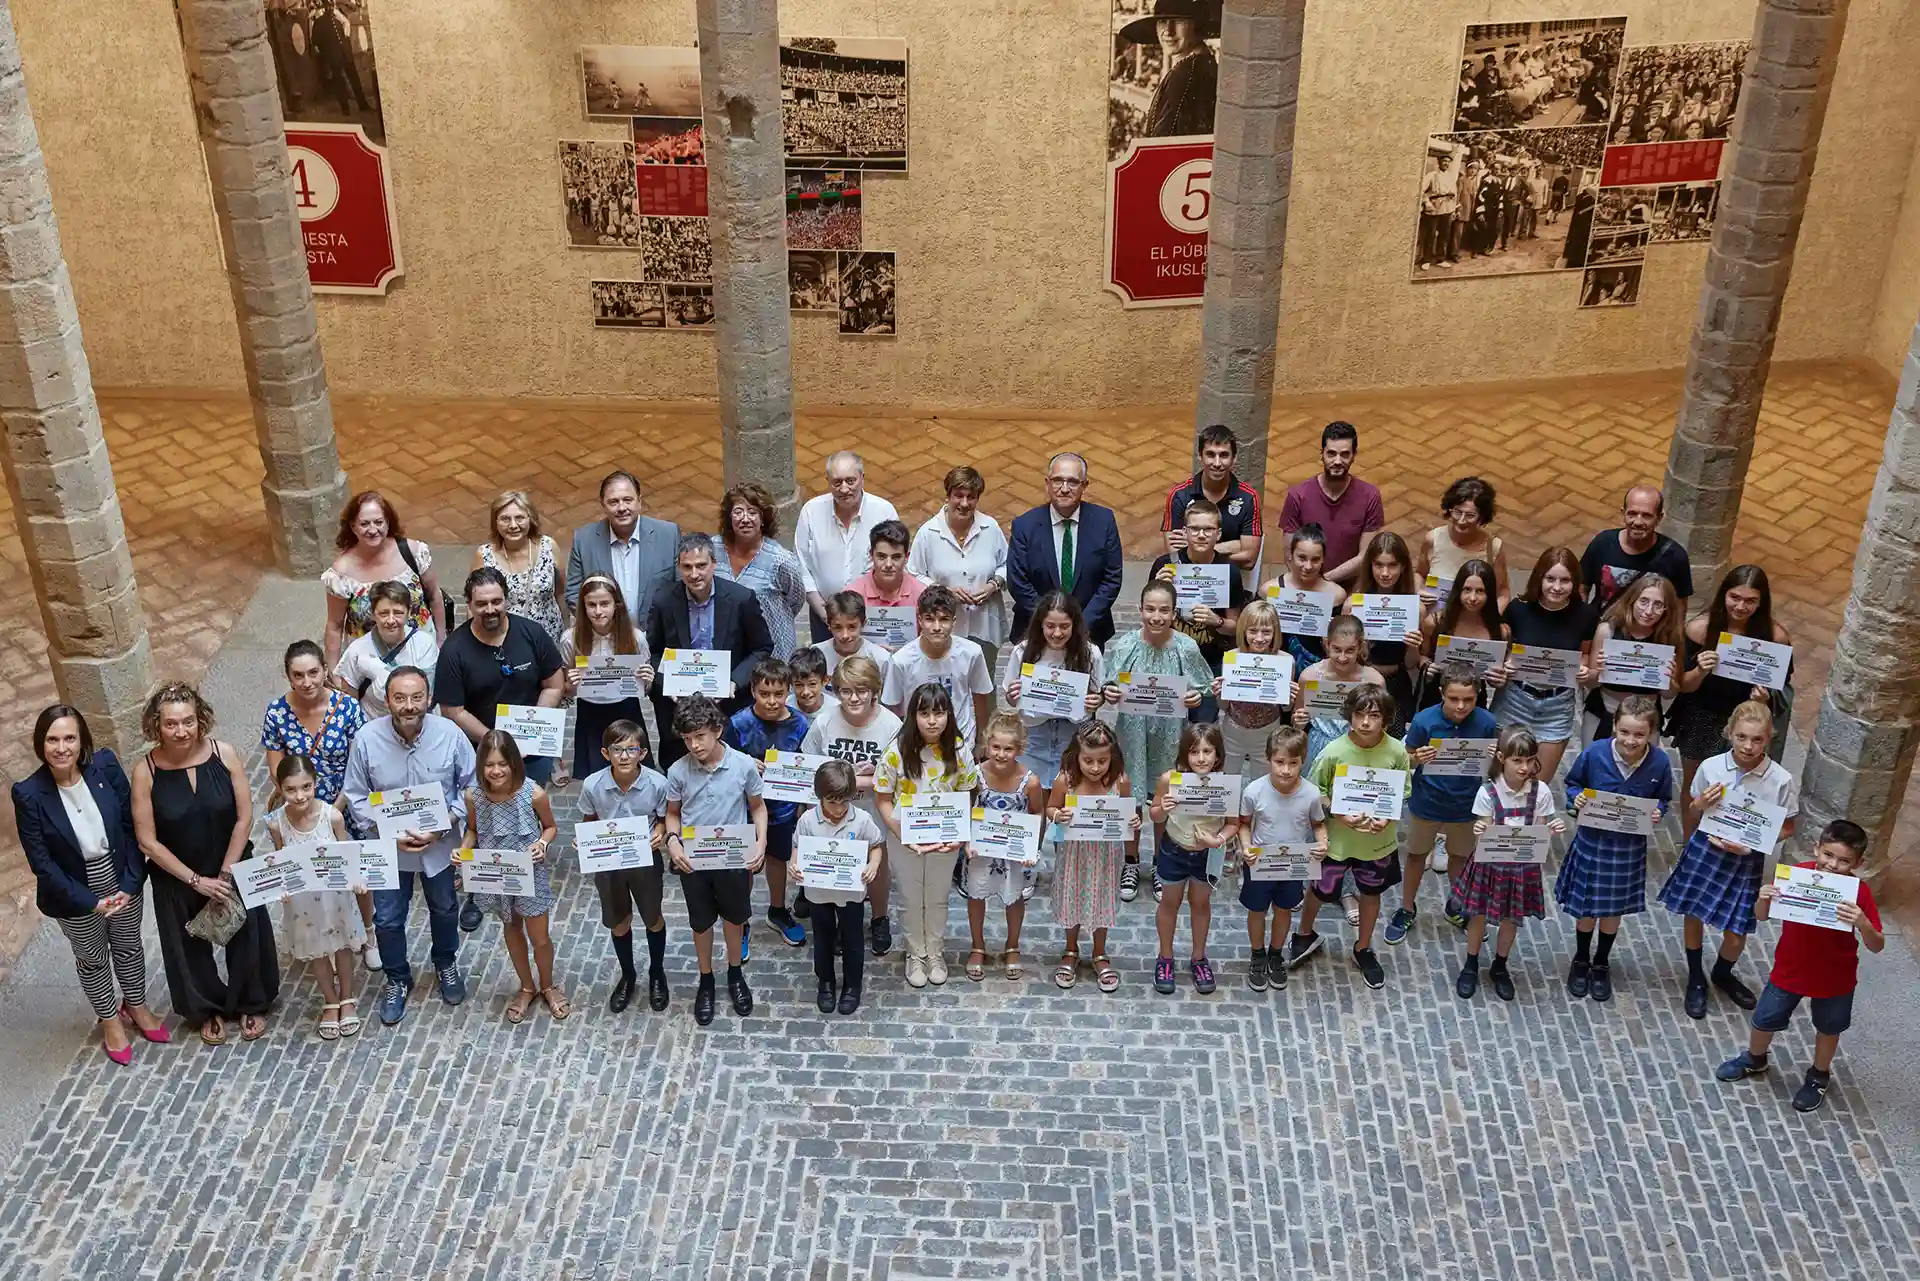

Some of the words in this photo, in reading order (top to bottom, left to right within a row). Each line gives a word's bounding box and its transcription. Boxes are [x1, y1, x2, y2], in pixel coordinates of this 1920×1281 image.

[292, 159, 318, 208] 4
[1181, 171, 1212, 221] 5
[304, 232, 348, 247] IESTA
[306, 250, 337, 265] STA
[1150, 246, 1169, 260] EL
[1172, 242, 1208, 259] PÚBL
[1156, 262, 1207, 277] IKUSLE
[828, 738, 882, 754] STAR
